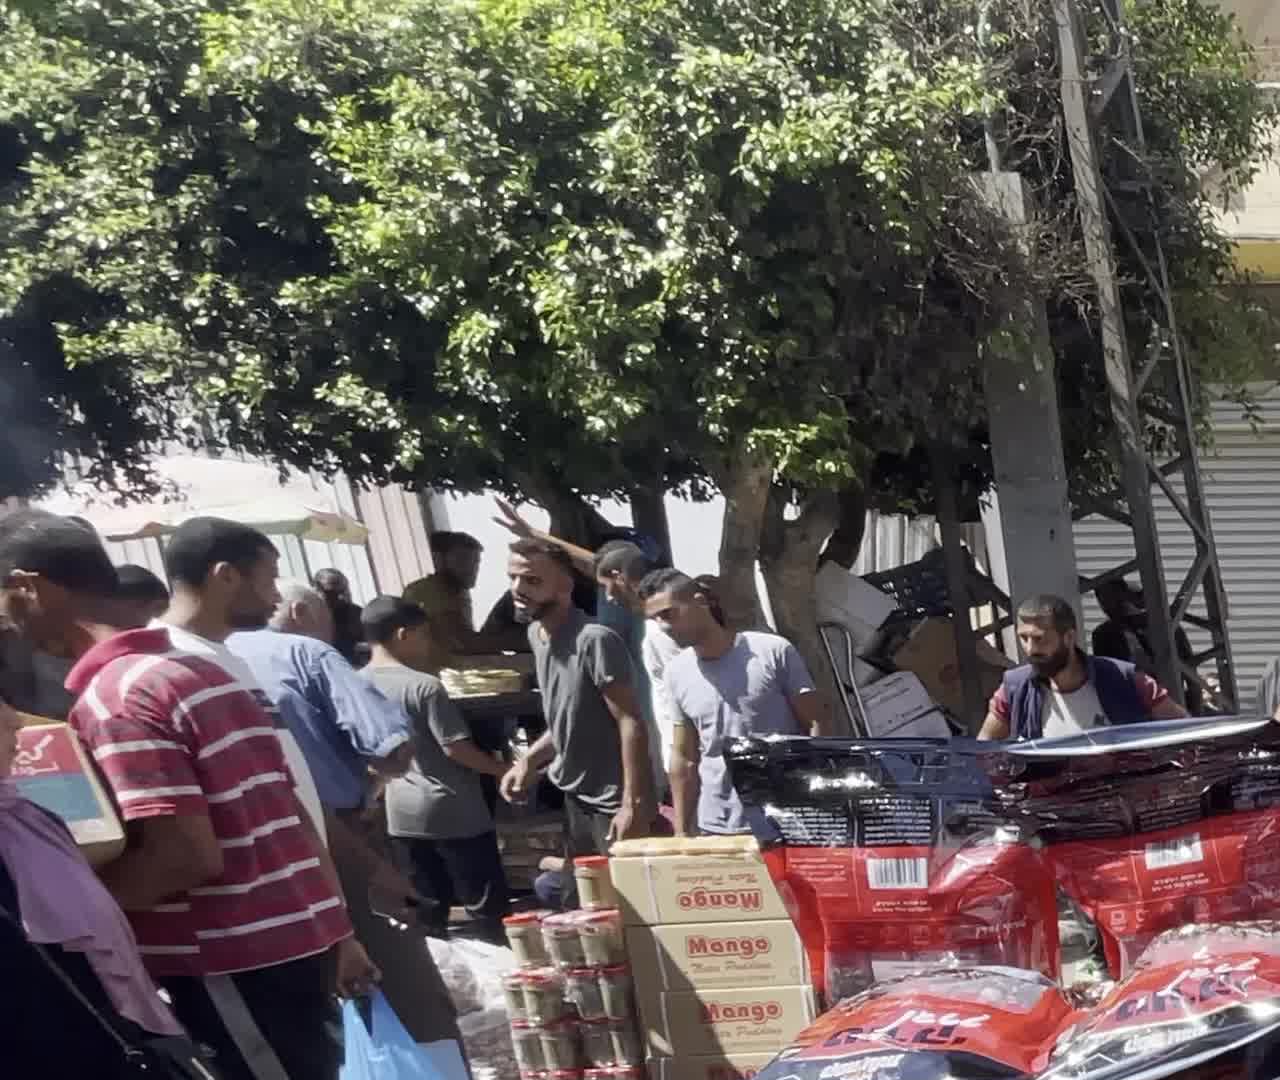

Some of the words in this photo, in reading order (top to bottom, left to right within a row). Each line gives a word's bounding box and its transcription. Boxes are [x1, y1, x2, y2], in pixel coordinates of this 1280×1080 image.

[677, 886, 764, 912] Mango
[686, 934, 770, 960] Mango
[700, 1000, 784, 1025] Mango
